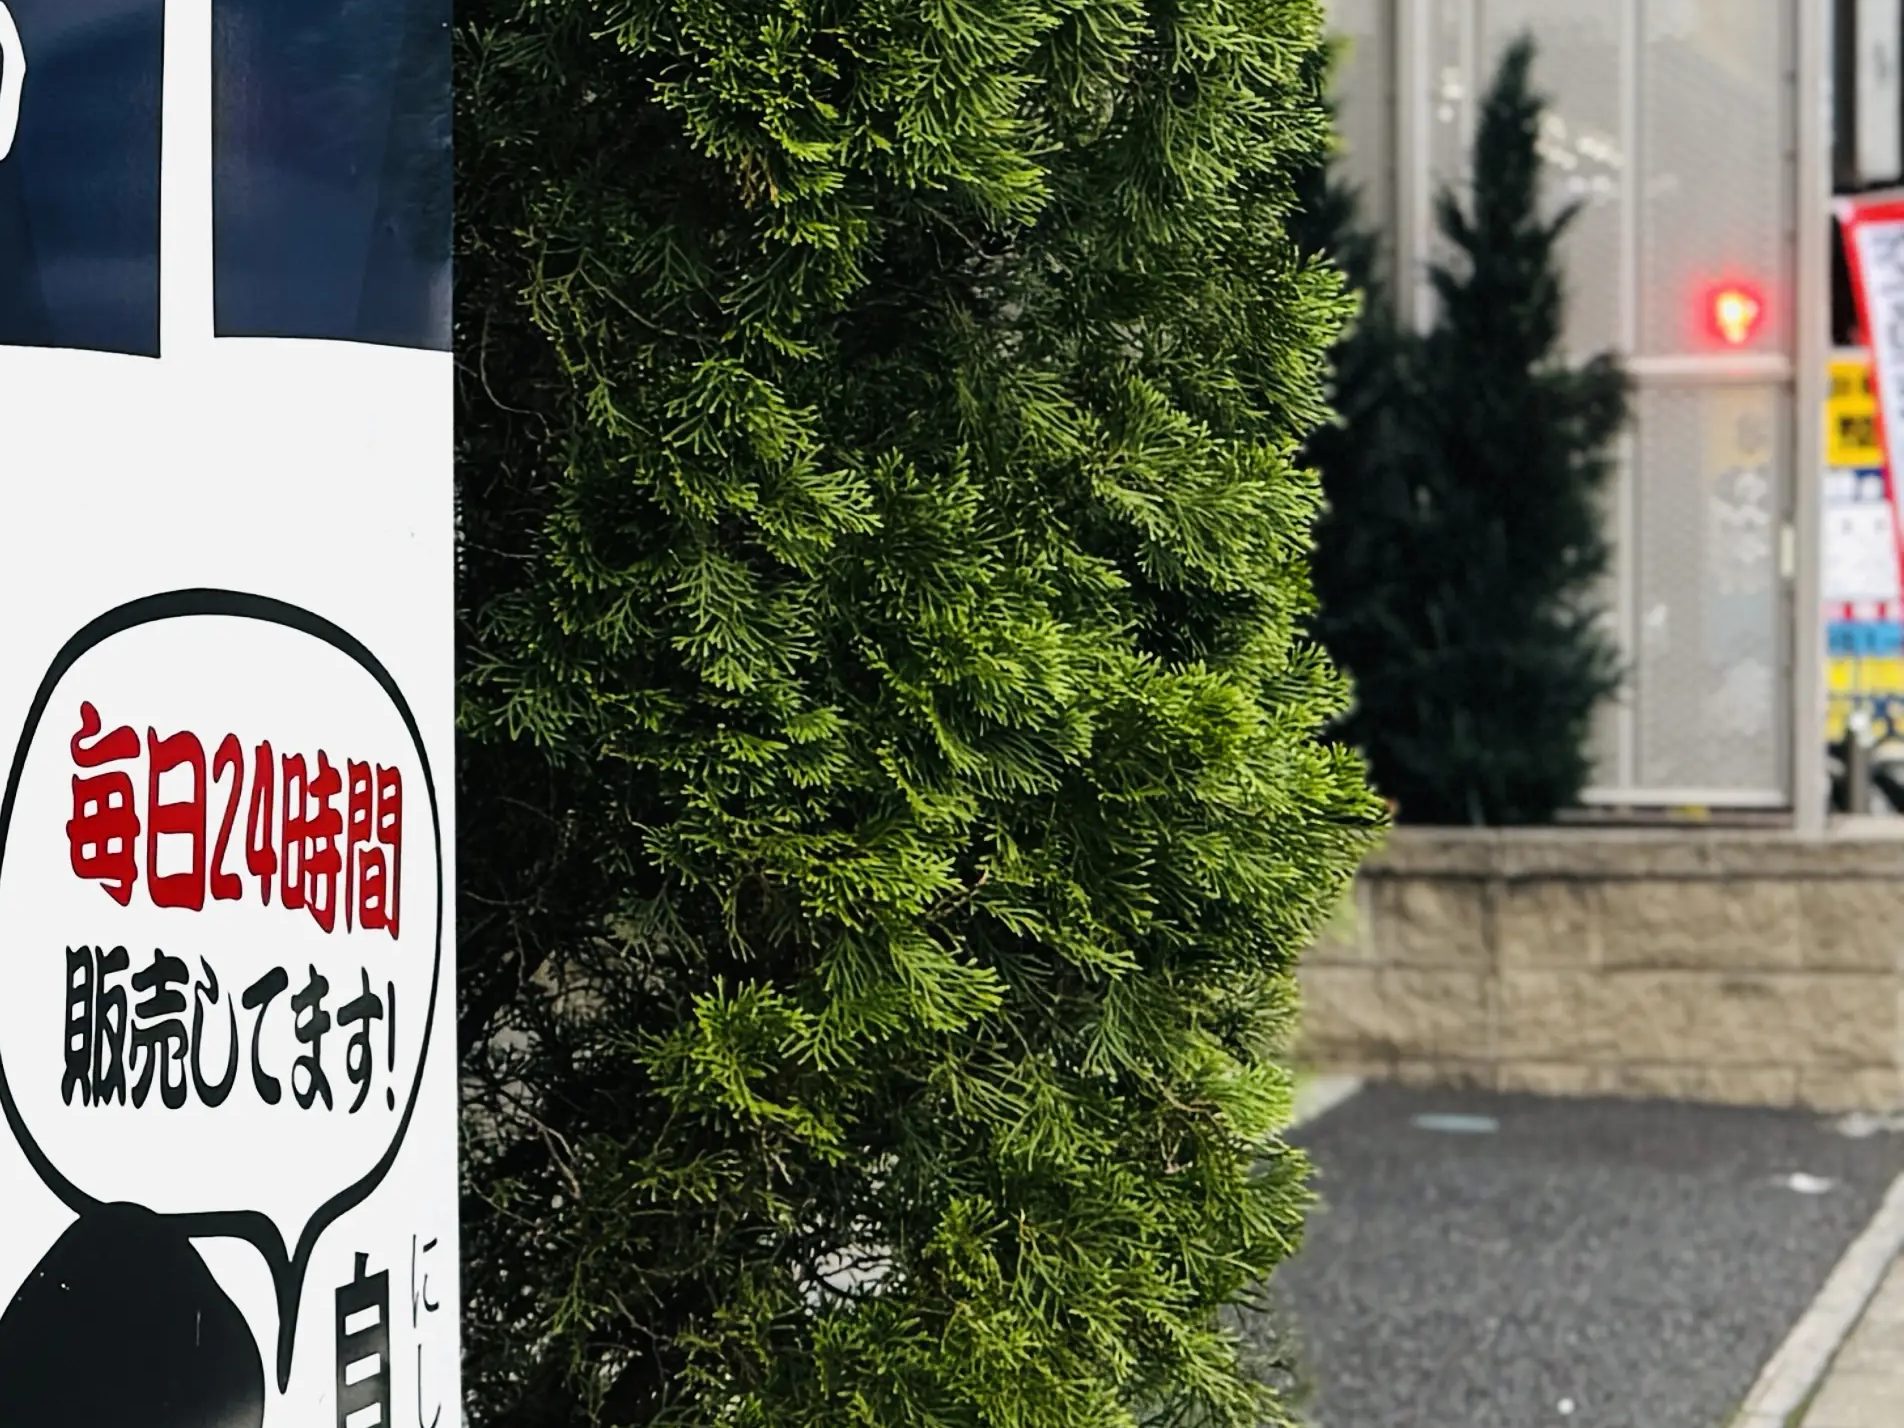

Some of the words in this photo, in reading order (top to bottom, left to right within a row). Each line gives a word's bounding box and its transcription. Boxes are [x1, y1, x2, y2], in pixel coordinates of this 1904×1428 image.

[66, 701, 403, 940] 毎日24時間
[61, 945, 396, 1114] 販売してます!
